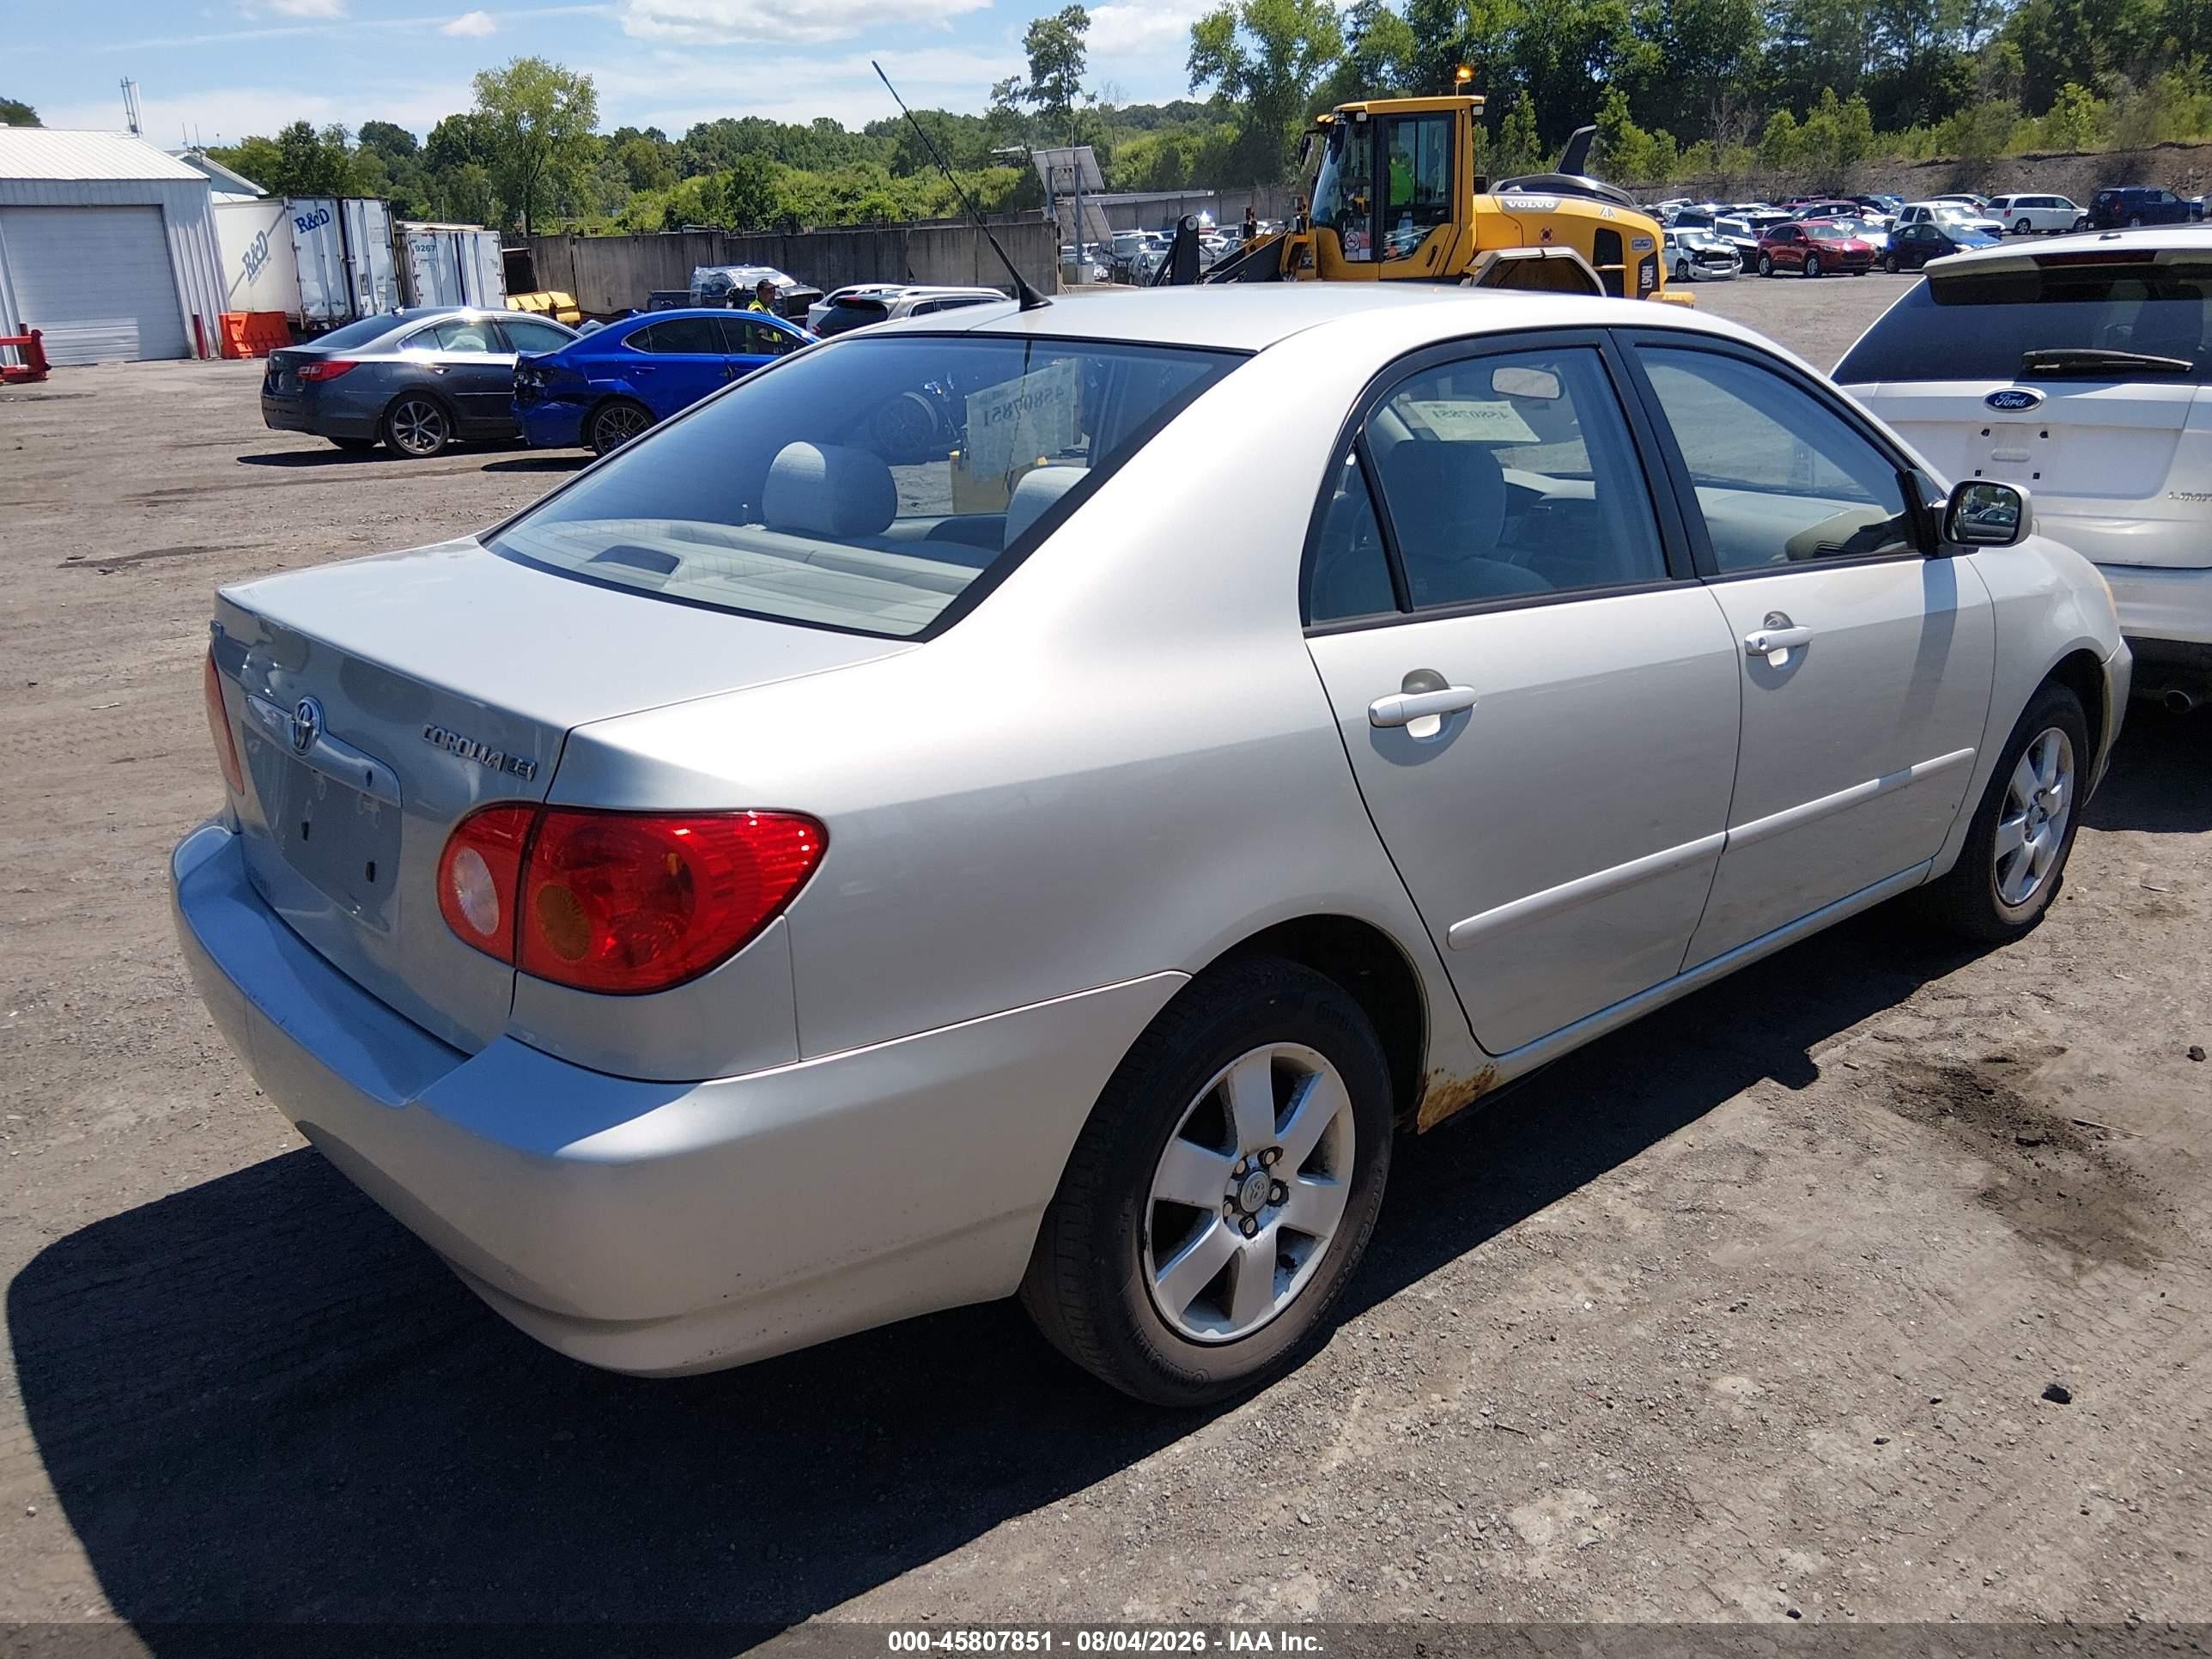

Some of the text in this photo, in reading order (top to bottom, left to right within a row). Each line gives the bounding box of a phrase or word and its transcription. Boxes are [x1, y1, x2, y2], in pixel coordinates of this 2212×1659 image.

[1505, 200, 1556, 209] VOLVO
[294, 208, 331, 234] R&D
[241, 230, 269, 283] R&D
[415, 244, 437, 252] 9267
[1641, 265, 1654, 289] L90H
[1994, 392, 2028, 407] Ford
[421, 723, 506, 772] COROLLA
